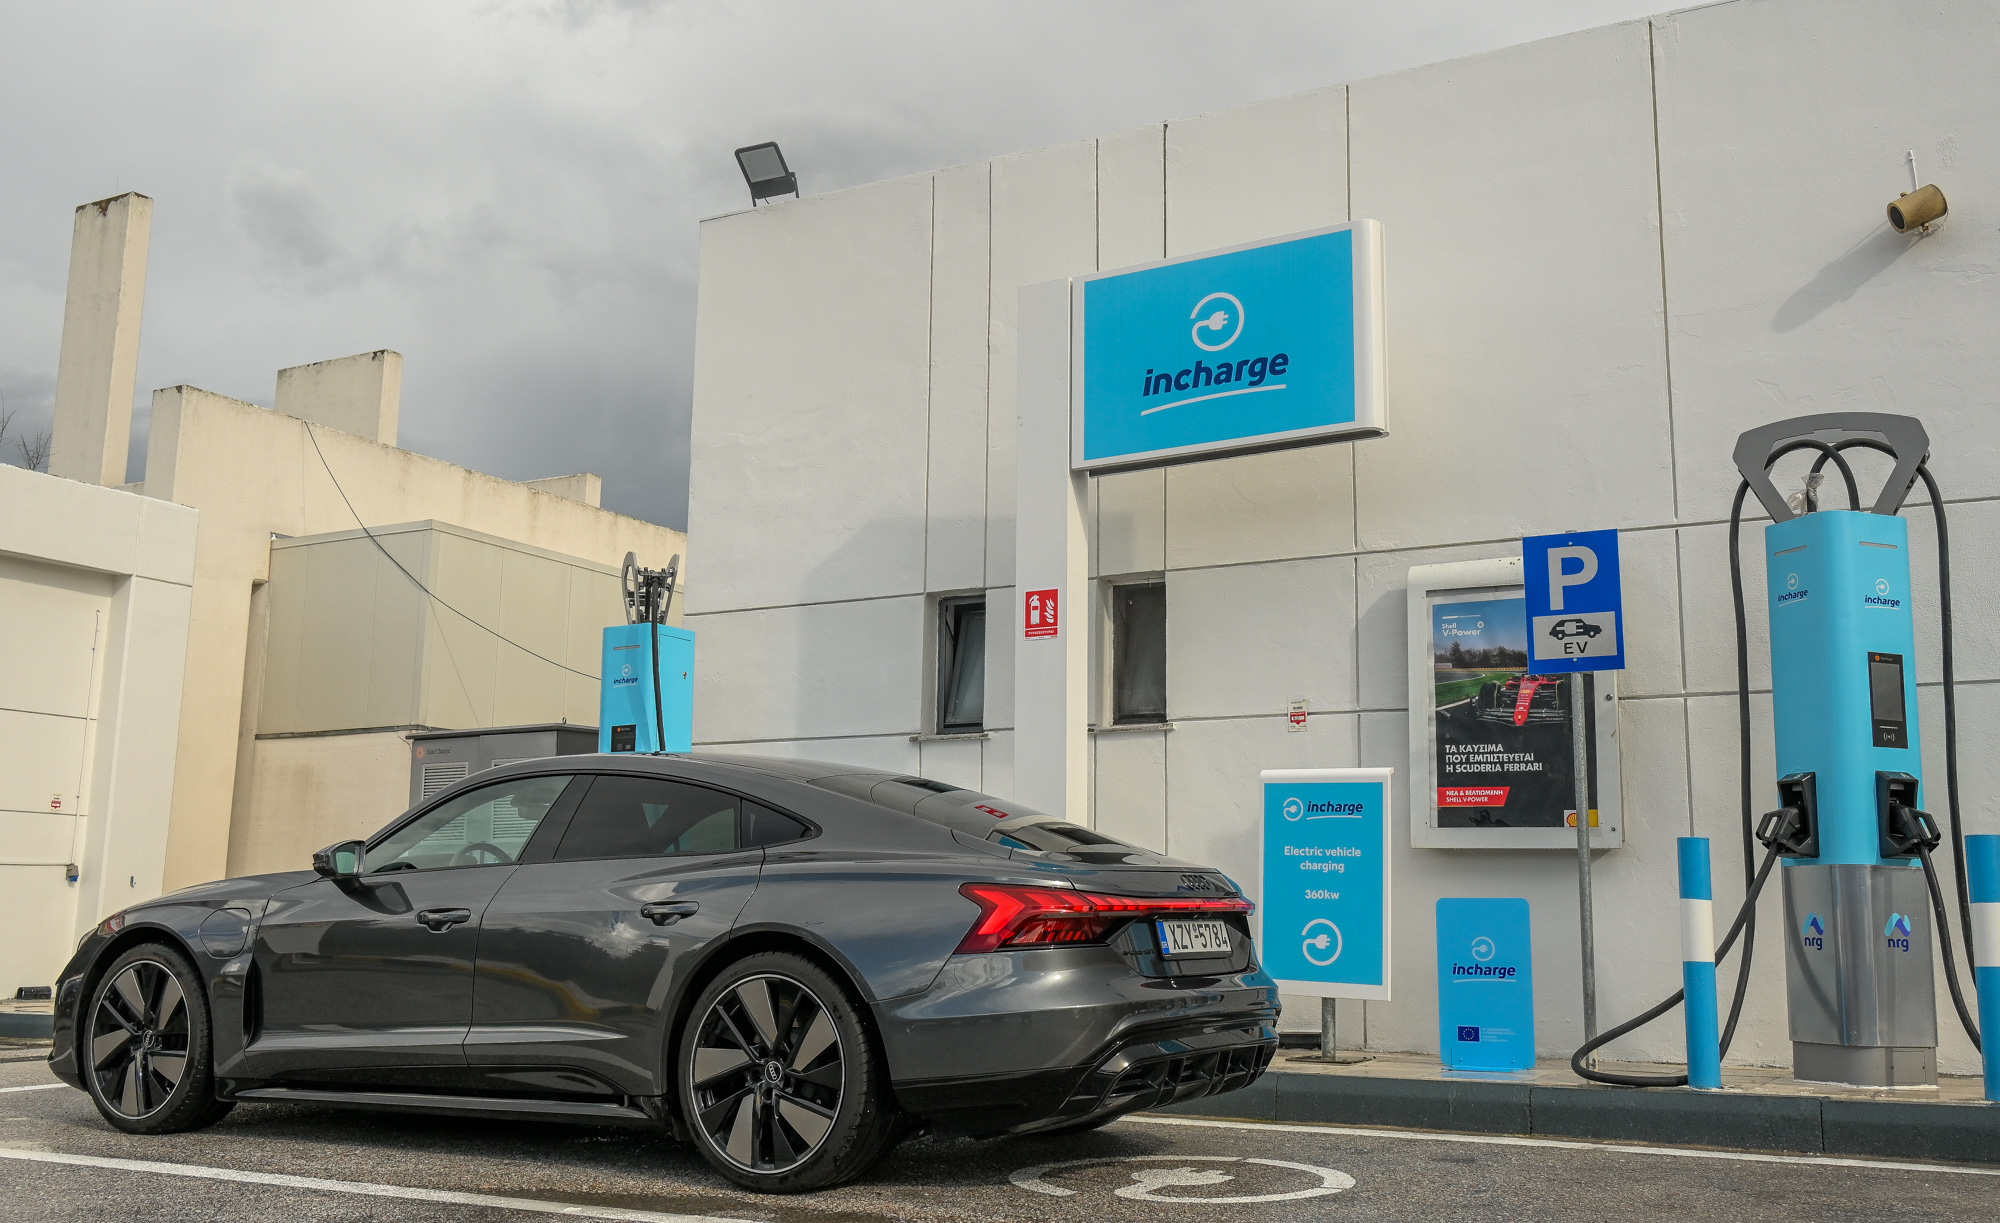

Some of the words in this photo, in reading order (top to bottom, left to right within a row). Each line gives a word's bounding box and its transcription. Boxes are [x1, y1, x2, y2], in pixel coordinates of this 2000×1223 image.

[1142, 352, 1289, 397] incharge
[1547, 546, 1598, 611] P
[1778, 589, 1808, 602] incharge
[1865, 595, 1900, 607] incharge
[1564, 641, 1588, 654] EV
[1445, 745, 1457, 753] ΤΑ
[1459, 744, 1504, 752] ΚΑΥΣΙΜΑ
[1445, 754, 1467, 763] ΠΟΥ
[1469, 753, 1534, 762] ΕΜΠΙΣΤΕΥΕΤΑΙ
[1455, 764, 1502, 772] SCUDERIA
[1504, 763, 1542, 771] FERRARI
[1307, 801, 1363, 815] incharge
[1284, 846, 1323, 856] Electric
[1325, 847, 1361, 856] vehicle
[1300, 860, 1345, 873] charging
[1305, 889, 1340, 899] 360kw
[1804, 937, 1823, 950] nrg
[1888, 938, 1909, 952] nrg
[1452, 963, 1516, 979] incharge
